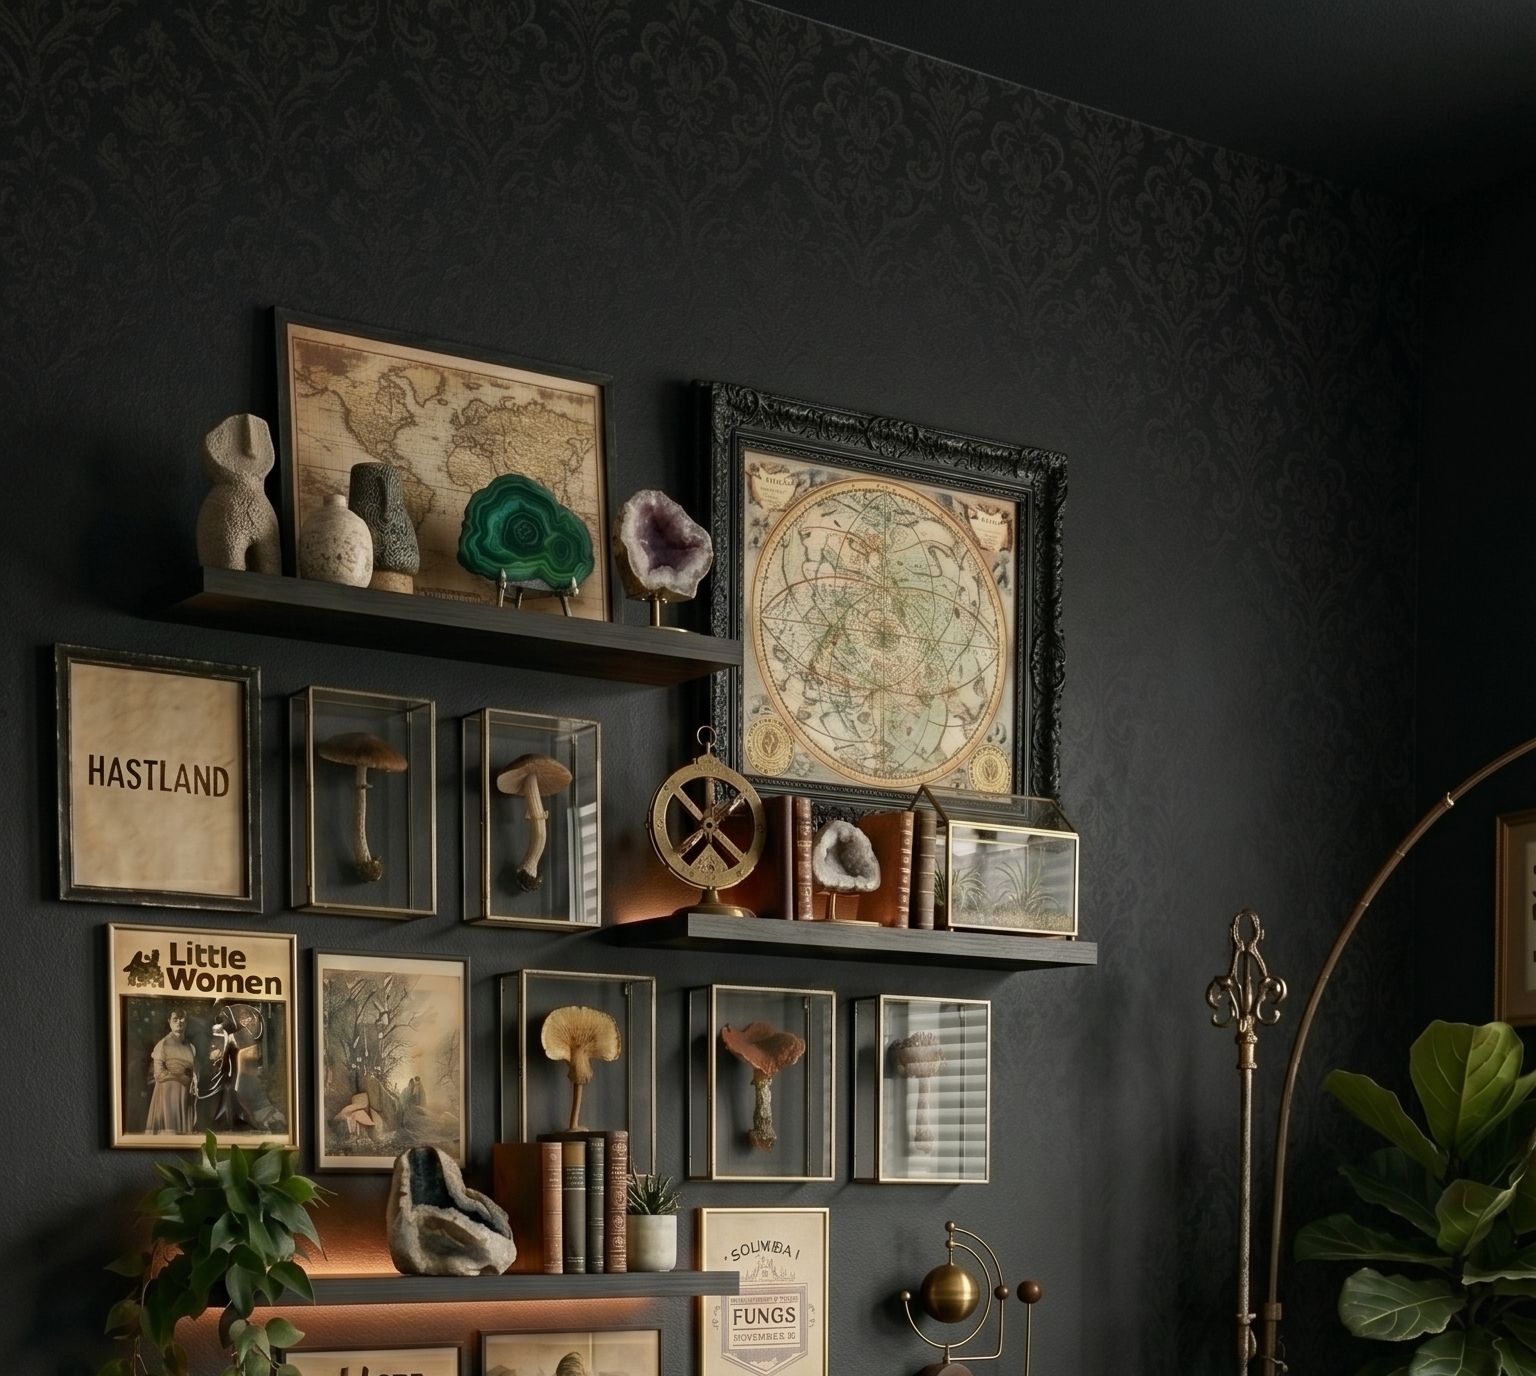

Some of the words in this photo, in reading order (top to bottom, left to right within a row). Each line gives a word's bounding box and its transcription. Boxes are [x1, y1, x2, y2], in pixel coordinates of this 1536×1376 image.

[88, 754, 229, 797] HASTLAND
[169, 941, 247, 970] Little
[166, 967, 282, 995] Women
[733, 1306, 796, 1325] FUNGS
